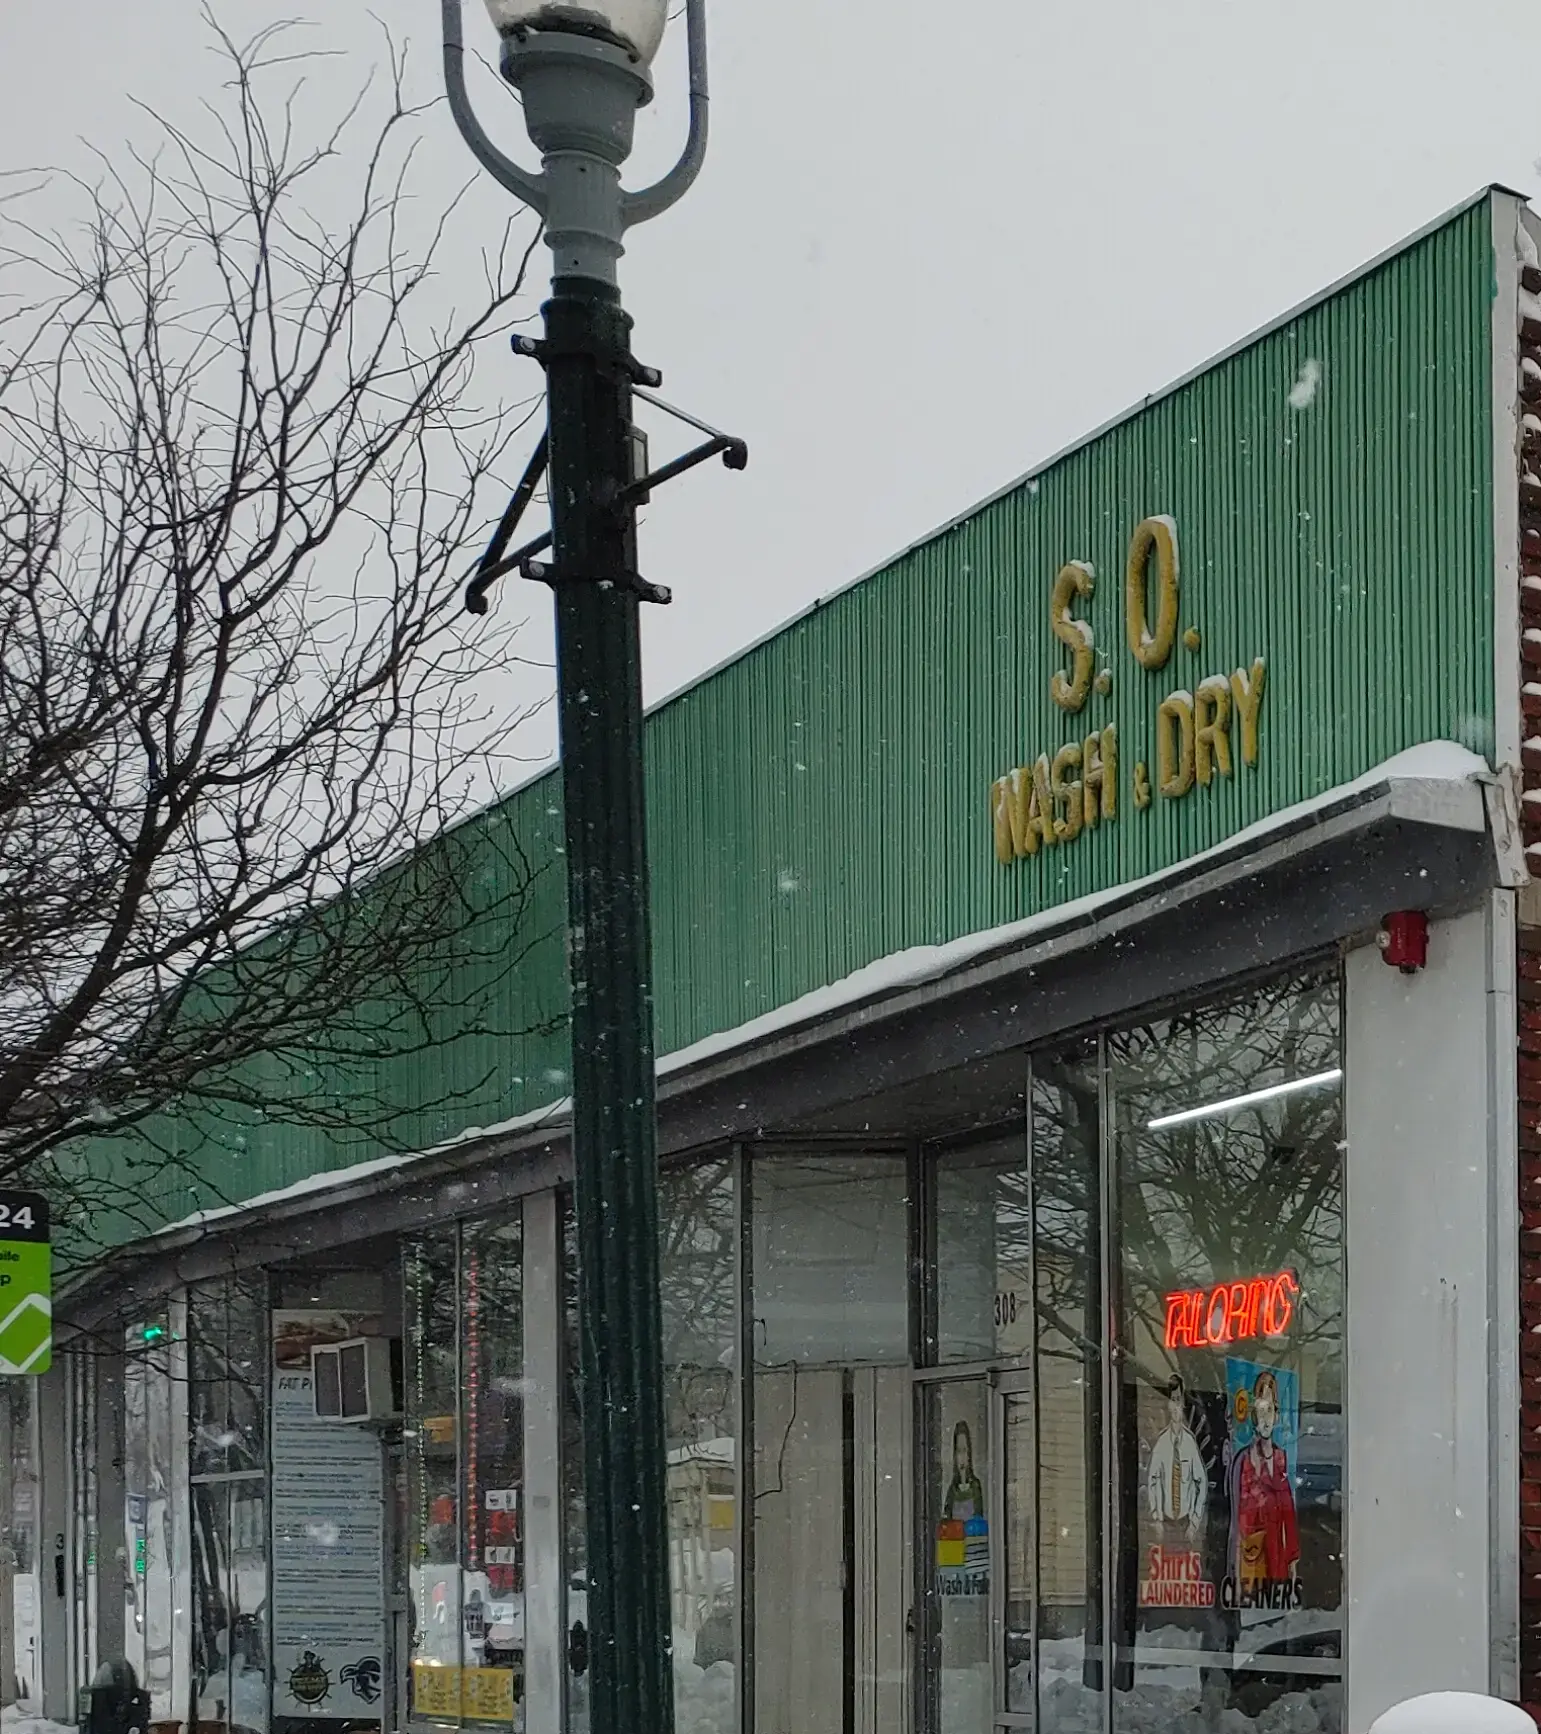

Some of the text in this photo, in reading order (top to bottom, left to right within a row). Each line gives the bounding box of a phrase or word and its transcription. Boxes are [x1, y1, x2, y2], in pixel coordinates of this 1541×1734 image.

[1051, 514, 1200, 714] S. O.
[991, 656, 1266, 866] WASH & DRY
[994, 1292, 1016, 1326] 308
[1165, 1271, 1299, 1348] TAILORING
[1149, 1546, 1201, 1581] Shirts
[935, 1573, 962, 1597] Wash
[1140, 1581, 1214, 1606] LAUNDERED
[1221, 1576, 1302, 1609] CLEANERS
